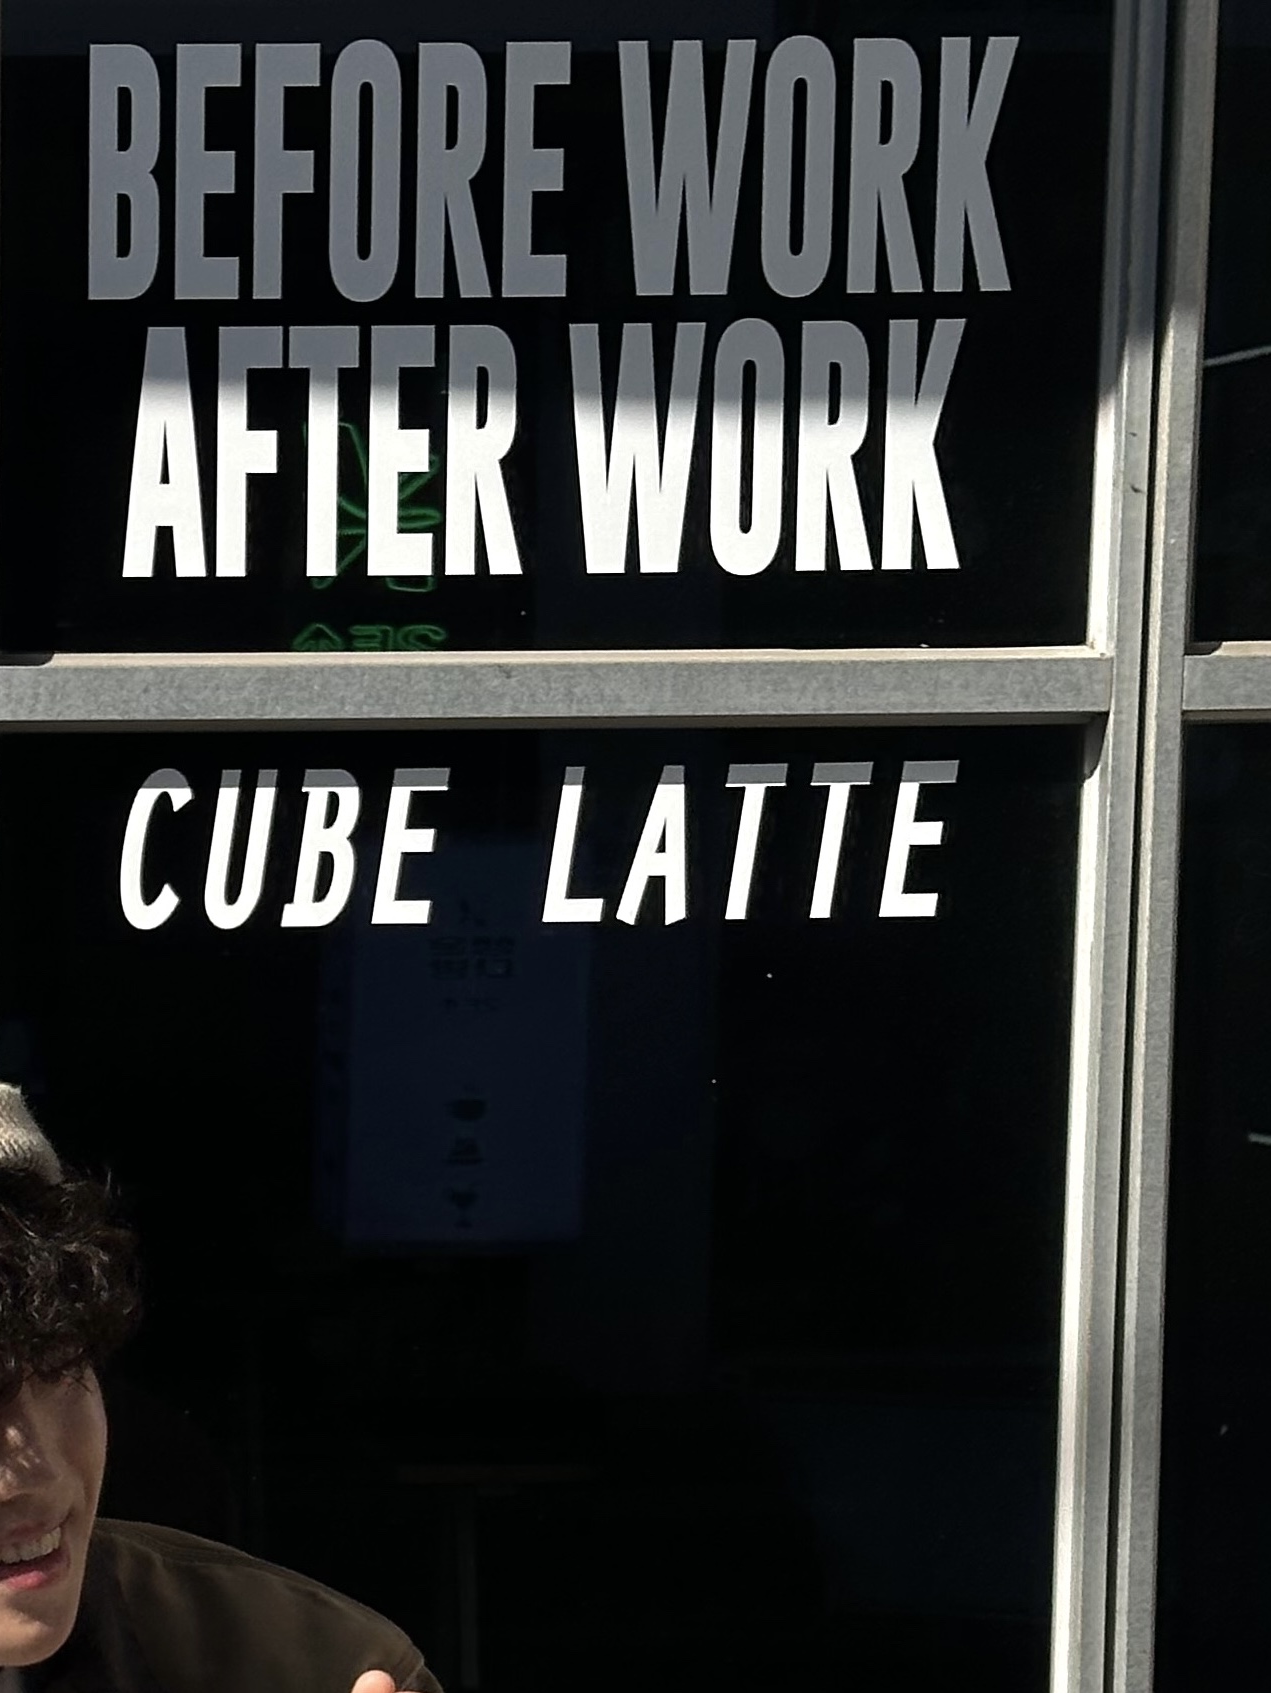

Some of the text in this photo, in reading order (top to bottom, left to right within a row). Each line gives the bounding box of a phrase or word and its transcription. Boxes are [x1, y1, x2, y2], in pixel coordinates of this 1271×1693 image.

[88, 35, 1020, 303] BEFORE WORK
[121, 317, 967, 578] AFTER WORK
[119, 759, 960, 931] CUBE LATTE
